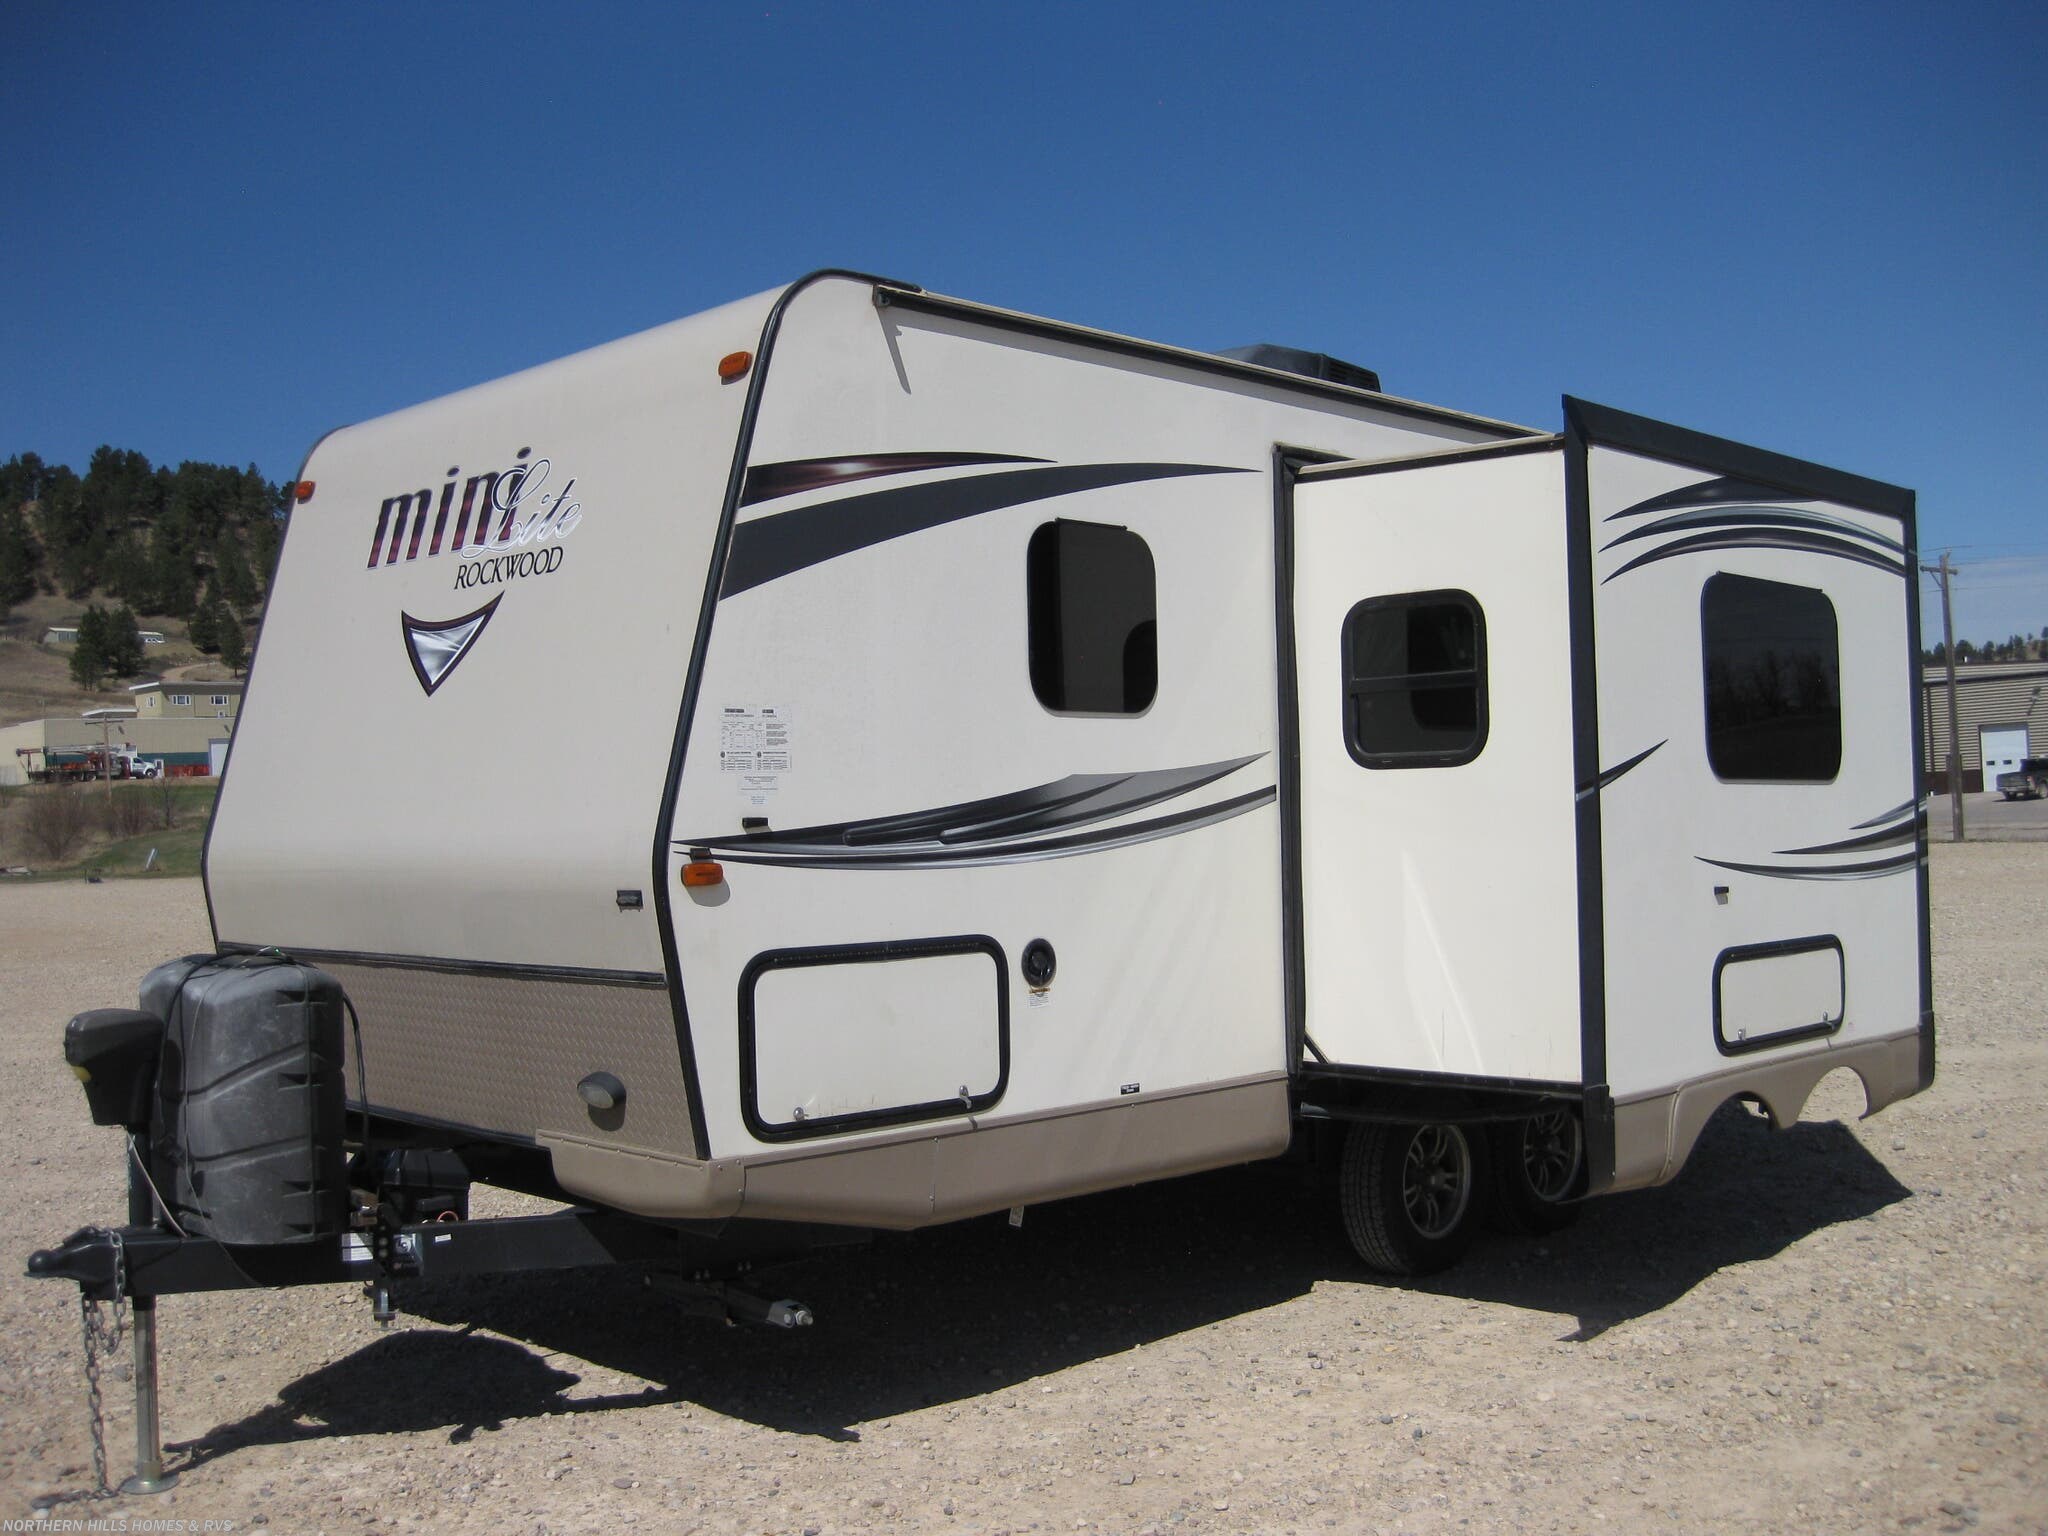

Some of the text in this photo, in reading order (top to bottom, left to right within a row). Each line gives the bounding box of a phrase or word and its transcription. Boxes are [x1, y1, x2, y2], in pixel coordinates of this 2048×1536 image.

[366, 446, 533, 569] mini
[461, 458, 583, 559] Lite
[453, 545, 564, 590] ROCKWOOD
